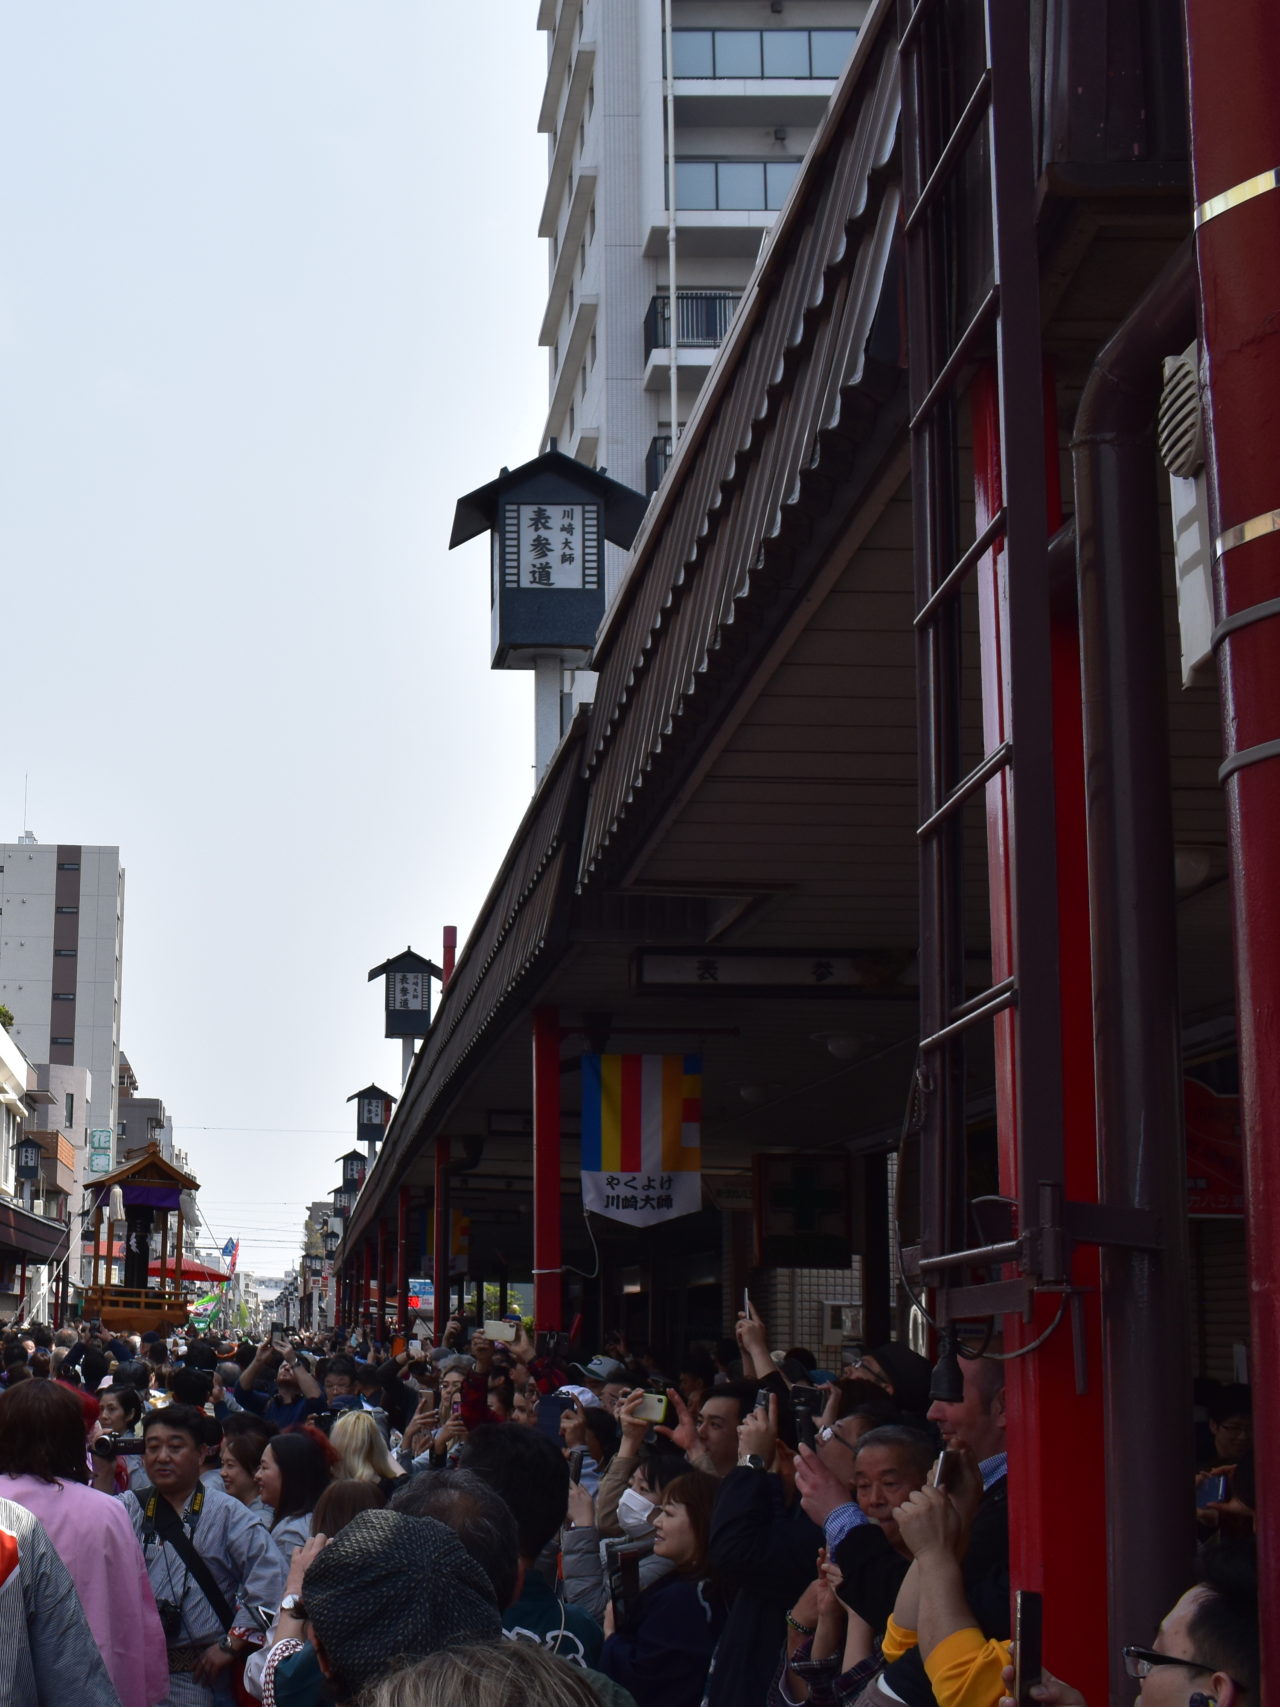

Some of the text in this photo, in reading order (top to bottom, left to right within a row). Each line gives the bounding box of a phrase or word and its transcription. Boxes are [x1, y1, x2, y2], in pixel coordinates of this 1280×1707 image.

[527, 506, 556, 587] 表参道
[605, 1175, 675, 1192] やくよけ
